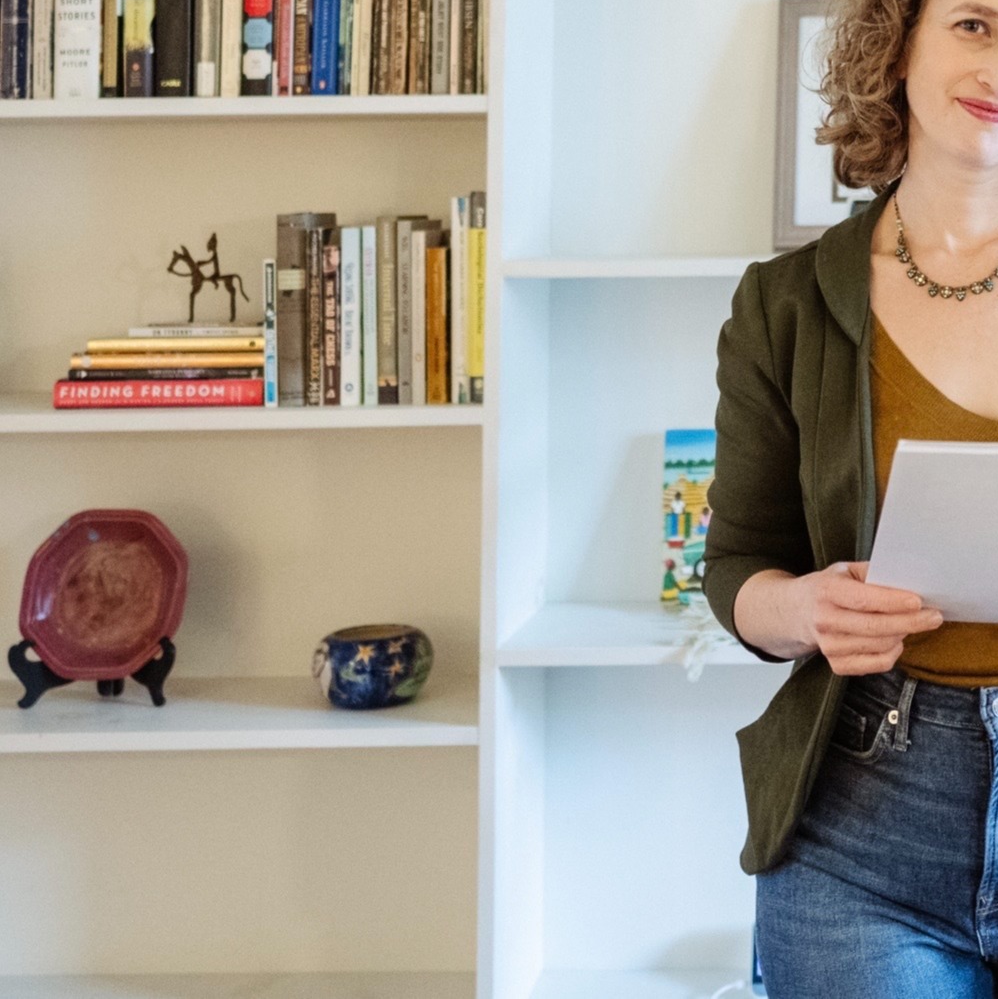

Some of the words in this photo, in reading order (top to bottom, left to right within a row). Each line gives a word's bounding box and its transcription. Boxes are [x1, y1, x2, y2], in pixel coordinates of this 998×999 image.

[58, 12, 96, 21] STORIES
[476, 207, 485, 227] Core
[476, 231, 485, 279] Sociological
[383, 264, 396, 308] Internal
[310, 297, 319, 345] ESSENTIAL
[325, 298, 336, 317] TAO
[325, 319, 336, 331] OF
[383, 315, 395, 345] Time
[309, 348, 319, 380] MARX
[325, 334, 336, 365] CHESS
[59, 385, 134, 399] FINDING
[140, 384, 226, 398] FREEDOM
